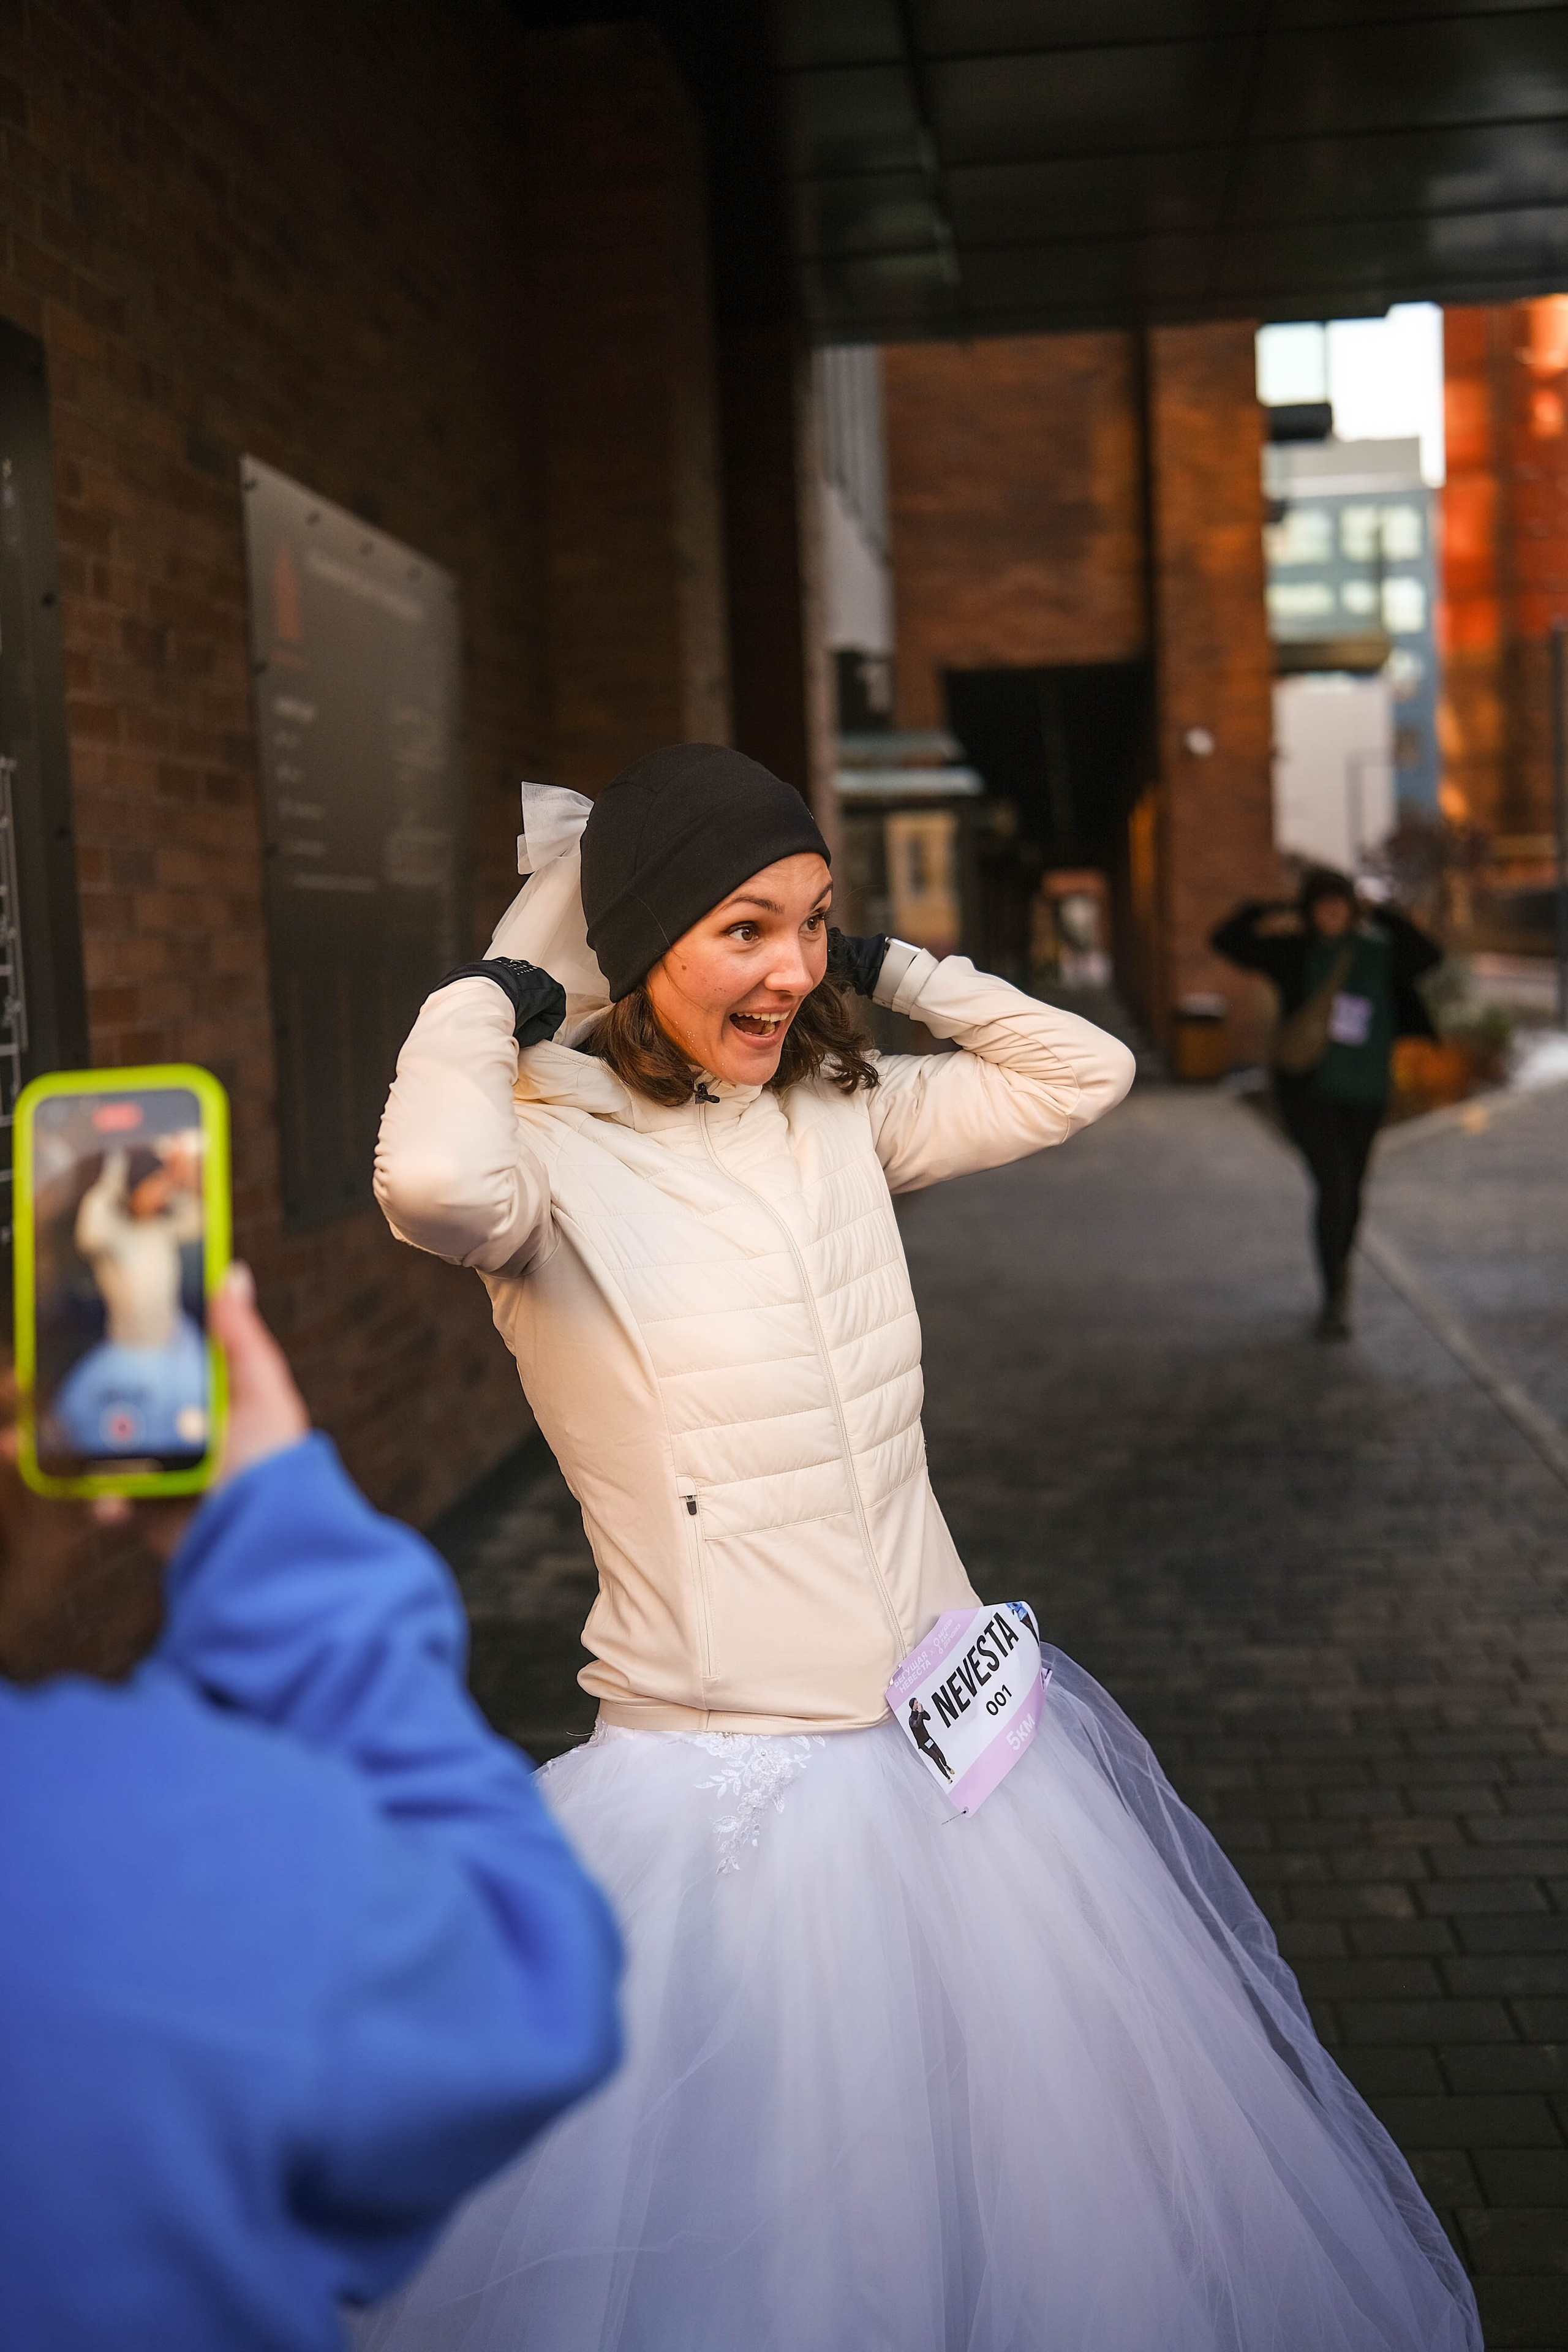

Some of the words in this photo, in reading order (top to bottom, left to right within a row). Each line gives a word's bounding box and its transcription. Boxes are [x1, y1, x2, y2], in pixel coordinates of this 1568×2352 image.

[894, 1650, 928, 1688] БЕГУЩАЯ
[899, 1659, 932, 1694] НЕВЕСТА
[931, 1612, 1019, 1728] NEVESTA
[986, 1684, 1012, 1716] 001
